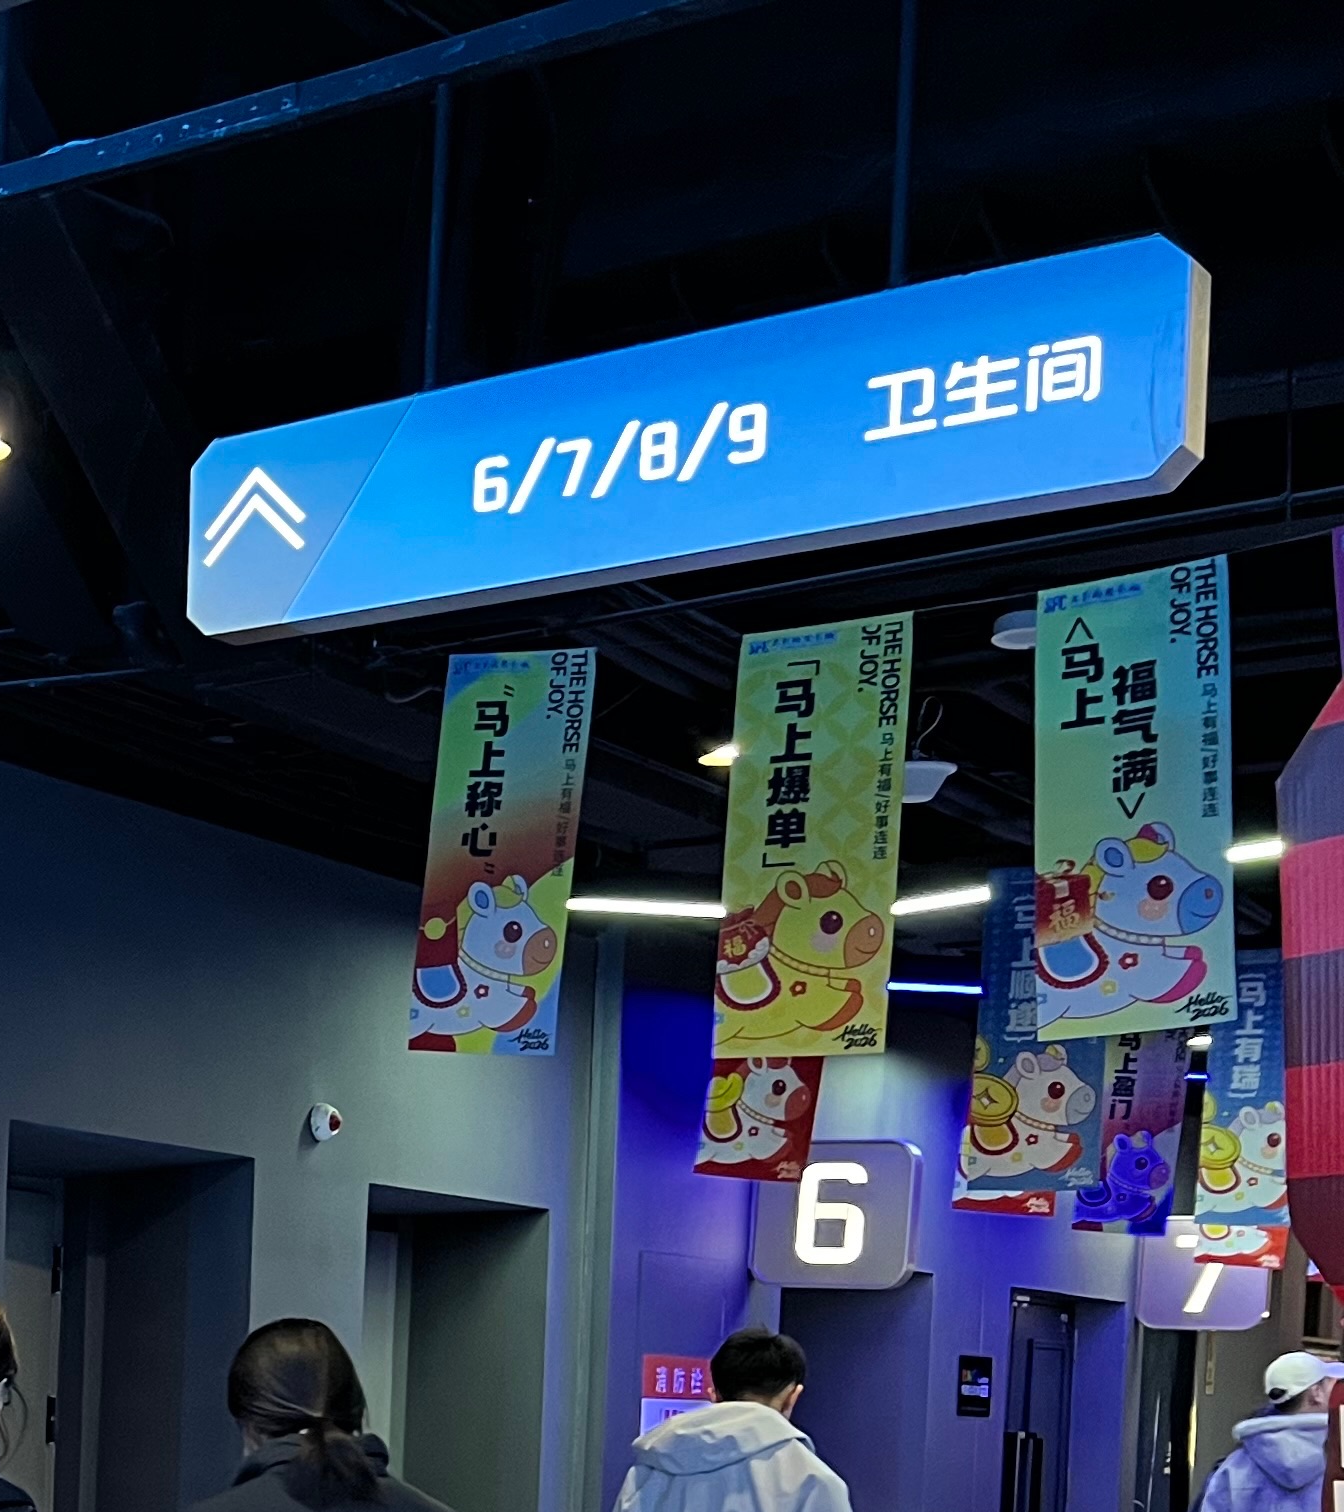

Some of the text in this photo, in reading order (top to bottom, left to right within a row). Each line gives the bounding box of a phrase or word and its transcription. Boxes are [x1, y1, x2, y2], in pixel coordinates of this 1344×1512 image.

[471, 334, 1103, 514] 6/7/8/9 卫生间
[1169, 565, 1192, 644] OF JOY.
[1194, 558, 1220, 680] THE HORSE
[545, 651, 568, 720] OF JOY.
[856, 648, 881, 694] JOY.
[878, 658, 902, 729] HORSE
[562, 650, 589, 754] THE HORSE
[1048, 899, 1081, 930] 福
[723, 935, 748, 959] 福
[1174, 991, 1233, 1014] Hello
[1189, 1003, 1230, 1021] 2026
[834, 1023, 881, 1041] Hello
[845, 1034, 879, 1050] 2026
[794, 1161, 868, 1266] 6
